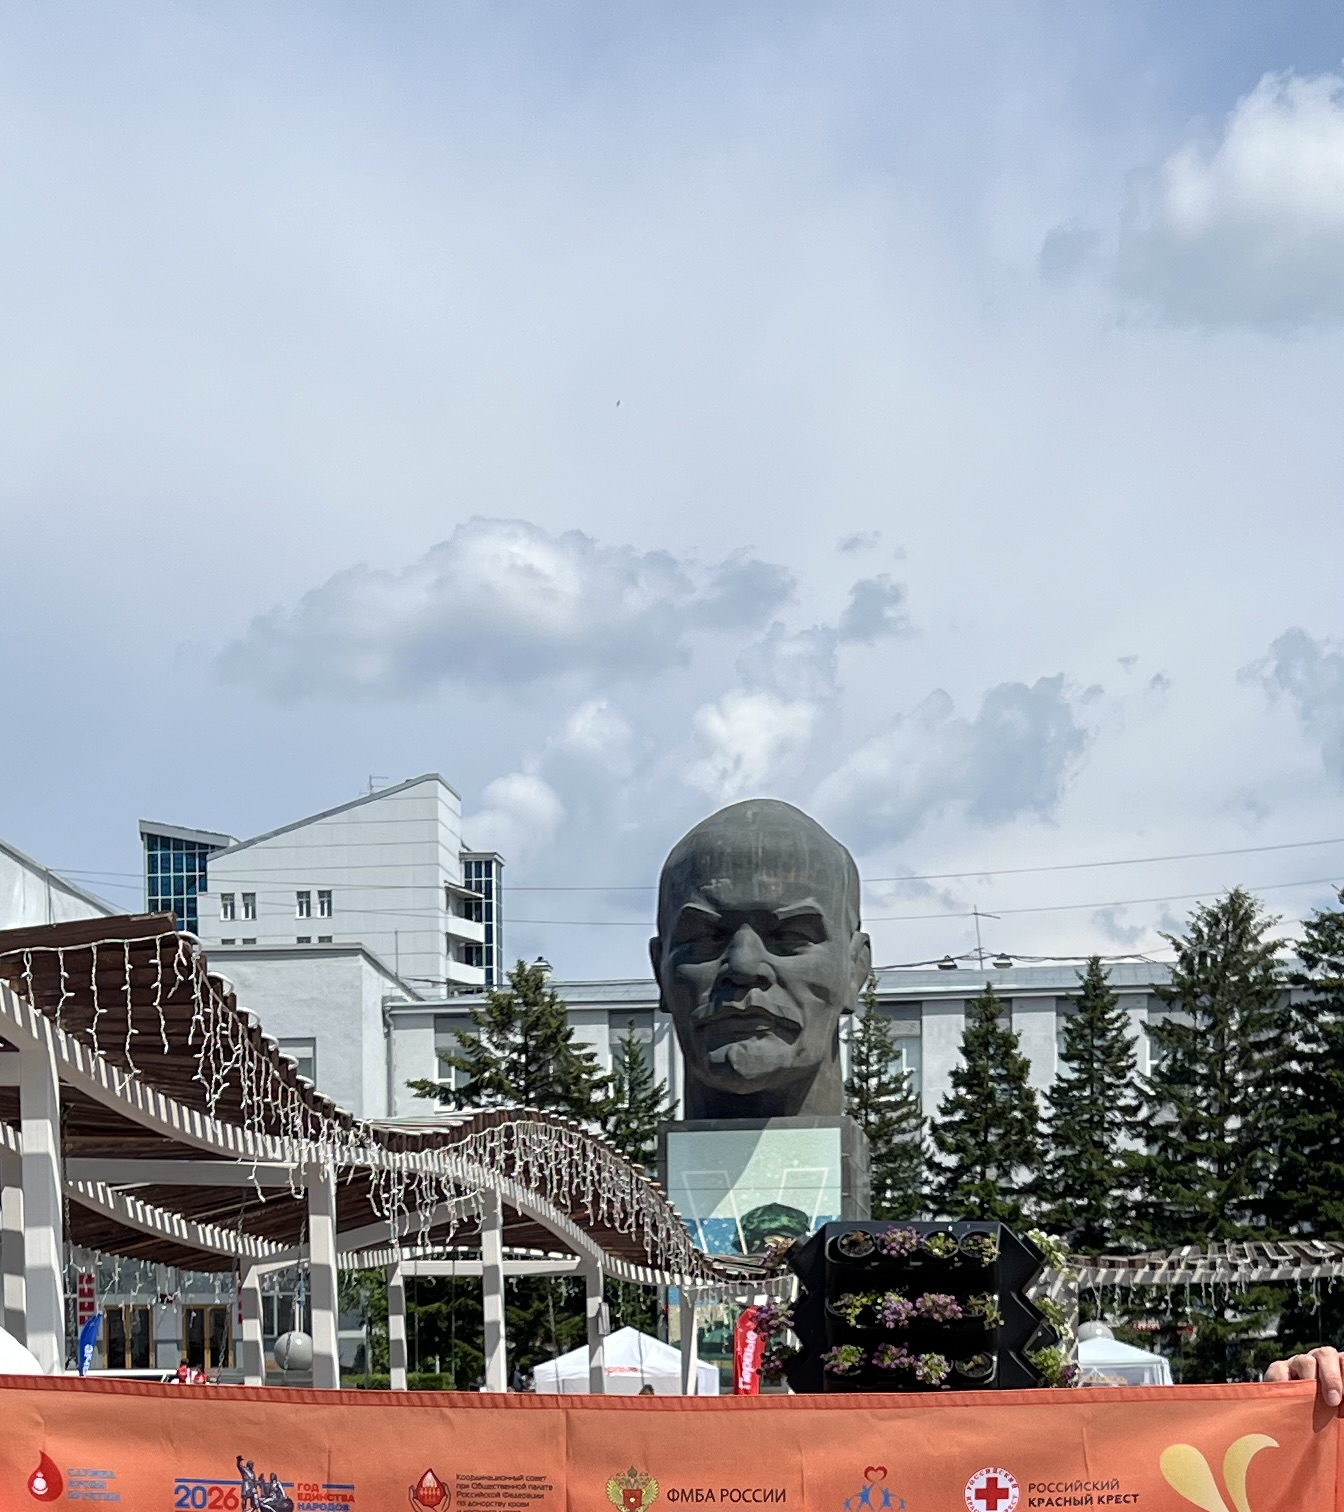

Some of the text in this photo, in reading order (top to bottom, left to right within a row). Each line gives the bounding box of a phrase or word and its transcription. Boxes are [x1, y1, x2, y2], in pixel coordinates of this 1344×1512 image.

[297, 1482, 320, 1494] ГОД
[471, 1482, 526, 1491] Общественной
[1027, 1478, 1120, 1494] РОССИЙСКИЙ
[174, 1485, 240, 1511] 2026
[297, 1492, 356, 1503] ЕДИНСТВА
[456, 1491, 501, 1499] Российской
[666, 1487, 787, 1503] ФМБА РОССИИ
[1027, 1493, 1139, 1508] КРАСНЫЙ КРЕСТ
[297, 1502, 350, 1512] НАРОДОВ
[467, 1500, 506, 1508] донорству
